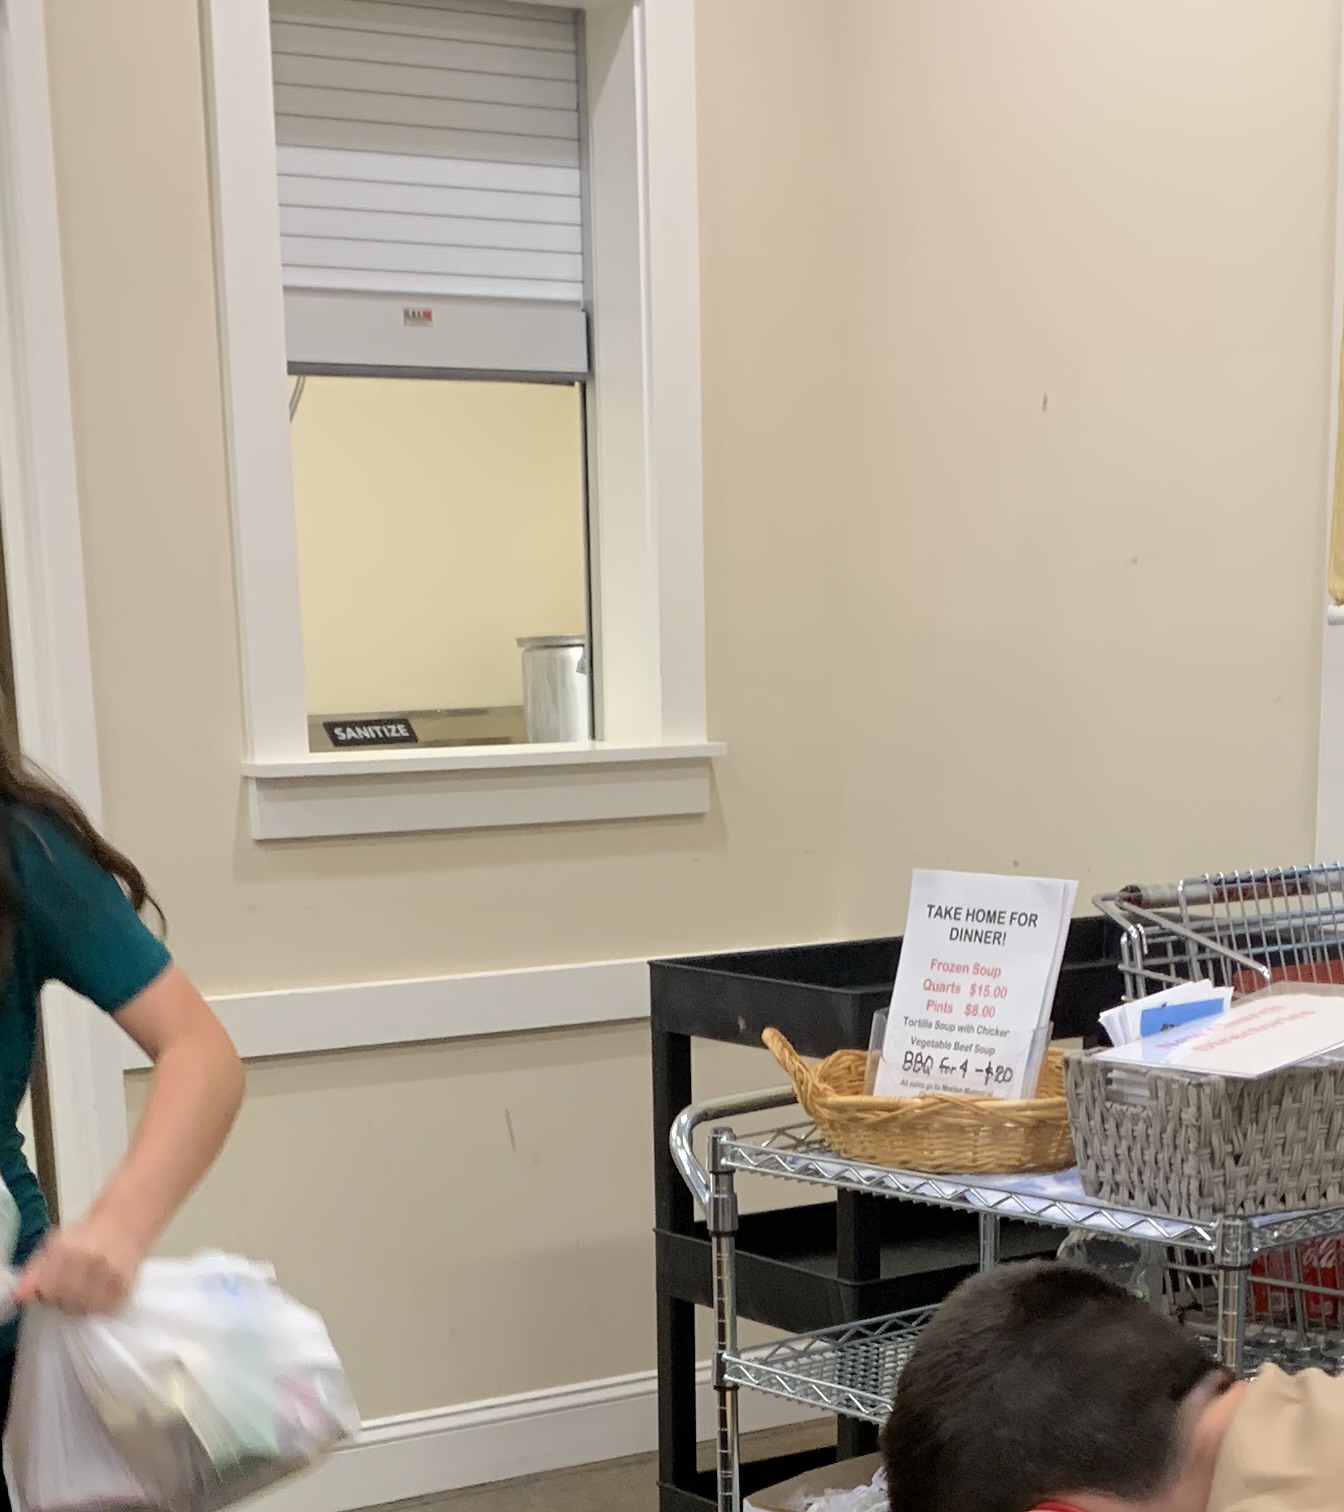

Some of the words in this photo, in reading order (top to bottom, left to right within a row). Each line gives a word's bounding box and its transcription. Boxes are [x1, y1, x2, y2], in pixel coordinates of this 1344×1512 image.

[334, 724, 409, 740] SANITIZE
[927, 904, 962, 921] TAKE
[965, 907, 1006, 925] HOME
[1009, 911, 1038, 928] FOR
[949, 927, 1007, 946] DINNER!
[930, 958, 969, 974] Frozen
[972, 963, 1002, 980] Soup
[922, 978, 961, 994] Quarts
[969, 983, 1008, 999] $15.00
[926, 999, 953, 1014] Pints
[964, 1003, 996, 1018] $8.00
[903, 1016, 933, 1029] Tortilla
[935, 1020, 956, 1033] Soup
[957, 1024, 975, 1034] with
[911, 1036, 952, 1050] Vegetable
[953, 1041, 974, 1053] Beef
[974, 1044, 996, 1057] Soup
[902, 1050, 934, 1076] BBQ
[959, 1058, 969, 1079] 4
